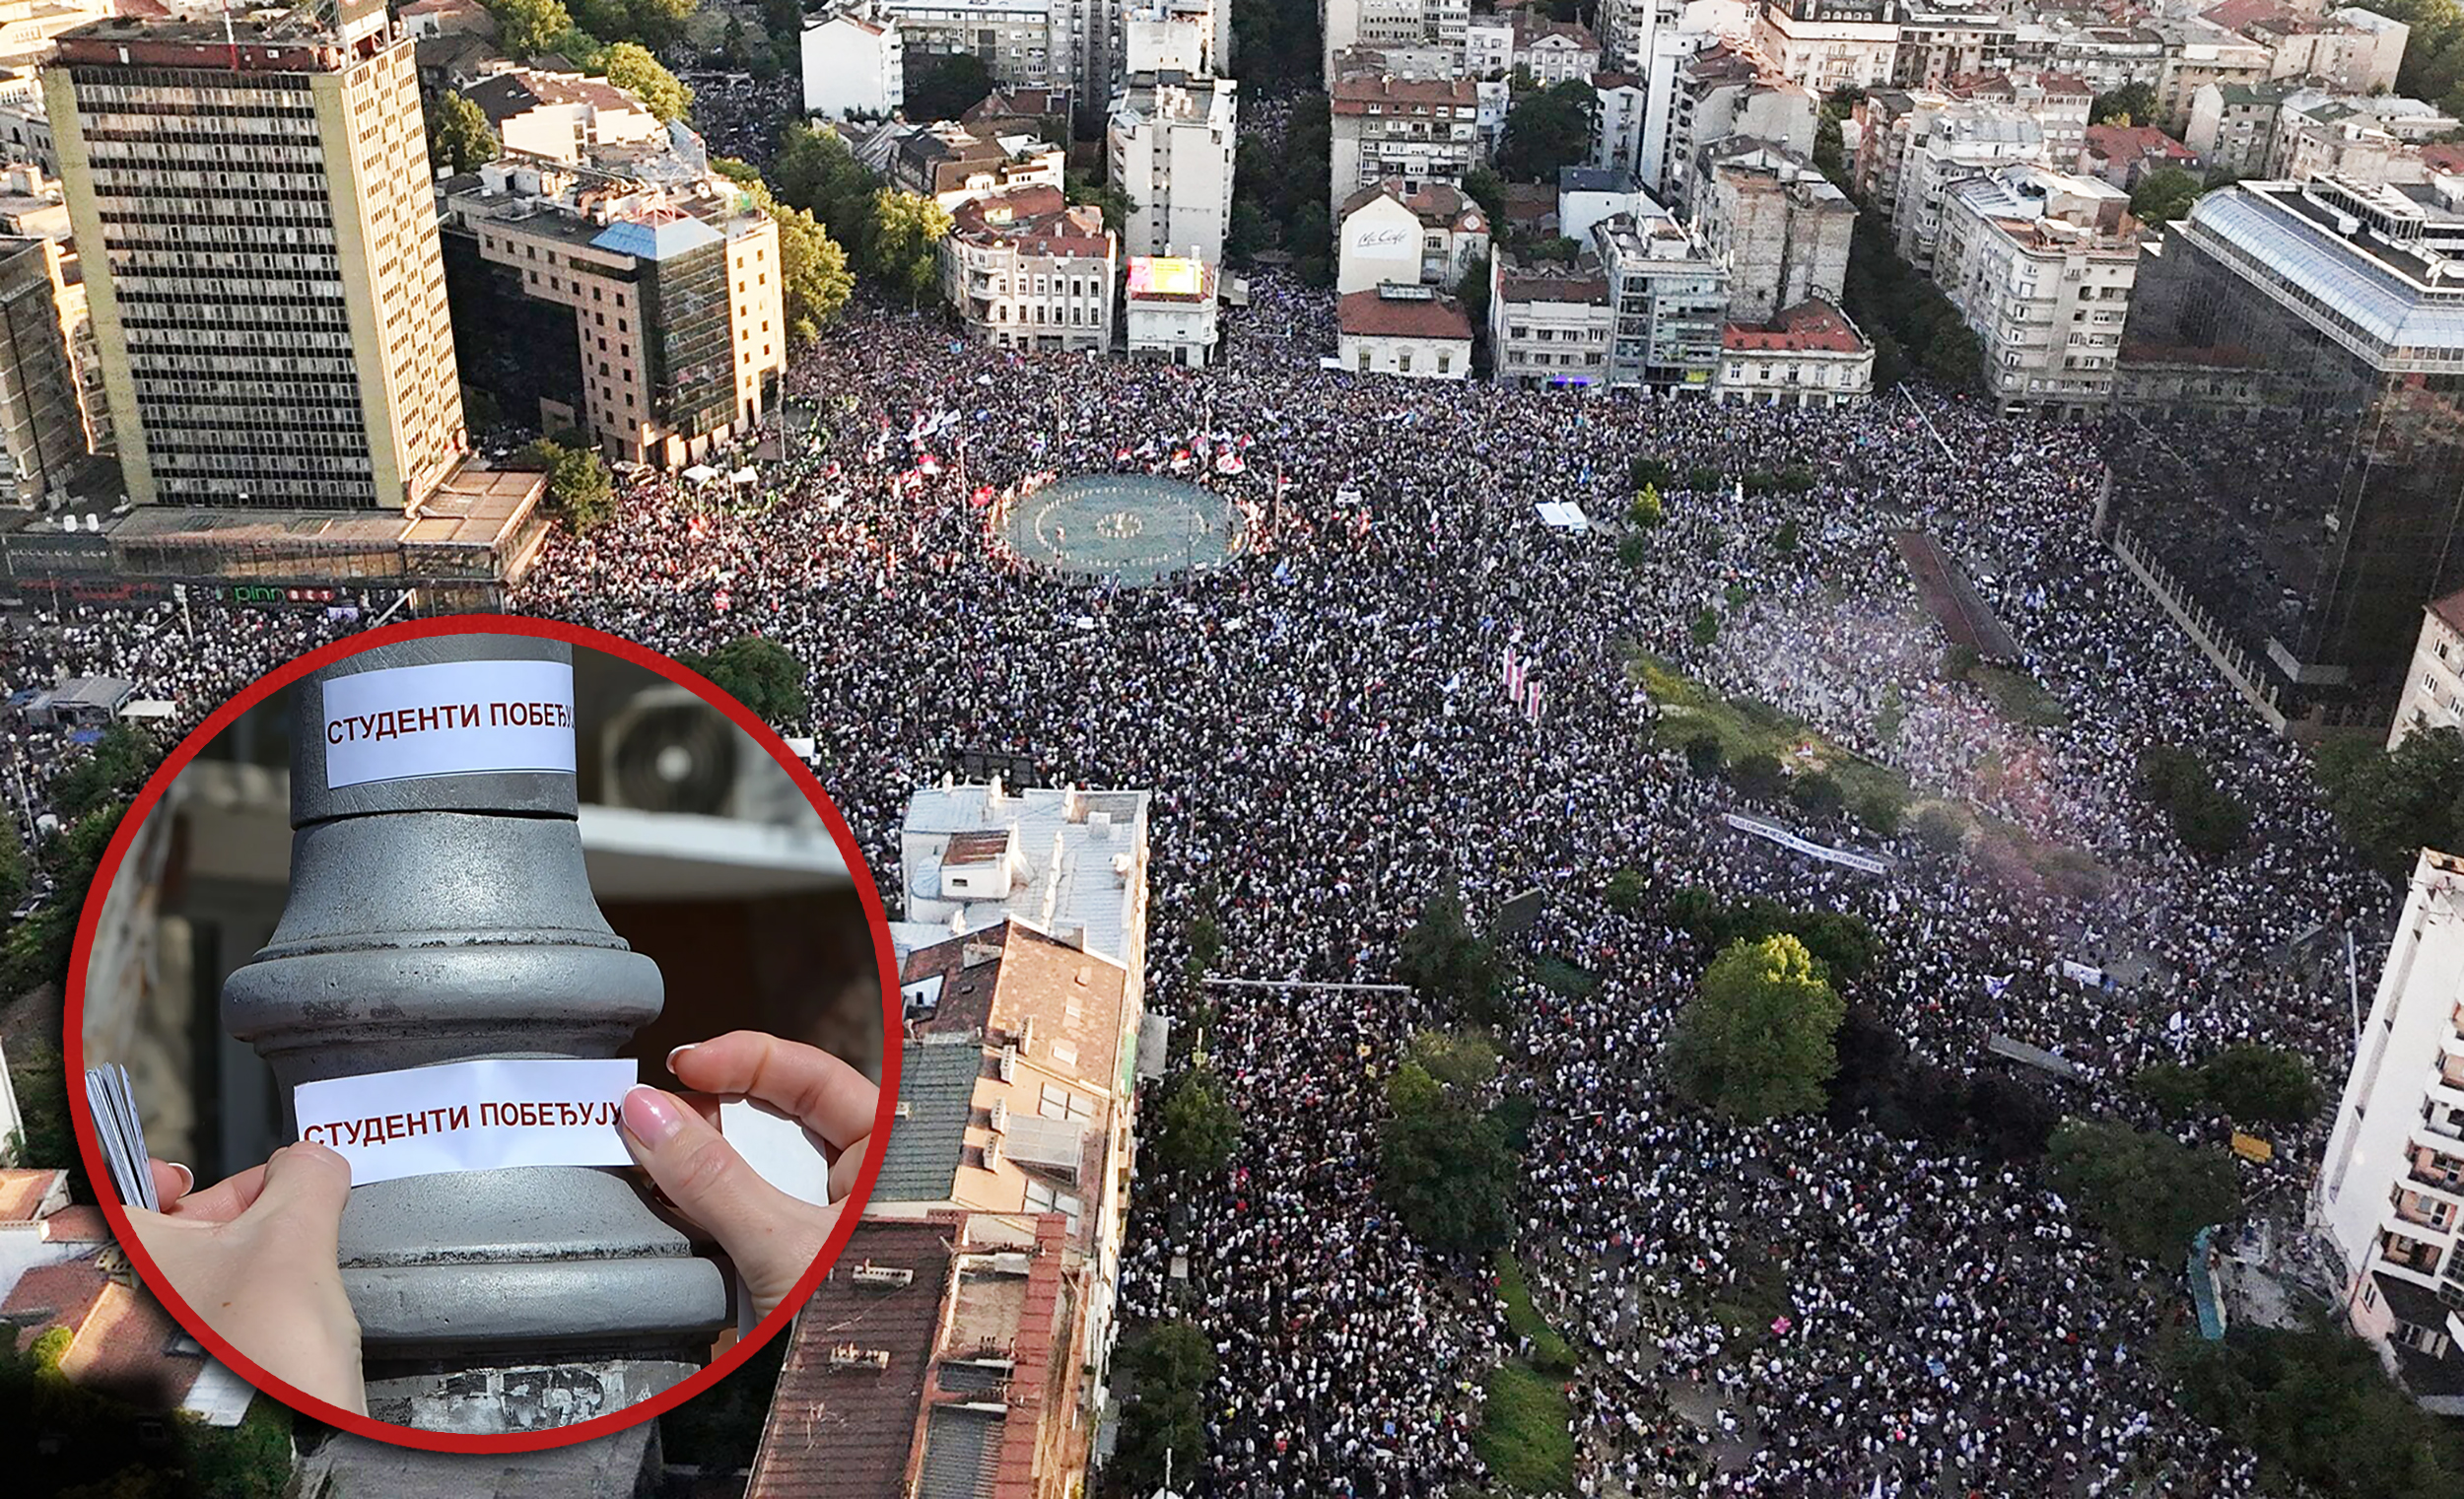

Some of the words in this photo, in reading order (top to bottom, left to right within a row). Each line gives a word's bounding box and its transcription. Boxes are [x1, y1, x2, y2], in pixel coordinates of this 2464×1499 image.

[327, 704, 480, 744] СТУДЕНТИ
[304, 1105, 470, 1146] СТУДЕНТИ
[480, 1102, 622, 1126] ПОБЕЂУЈУ
